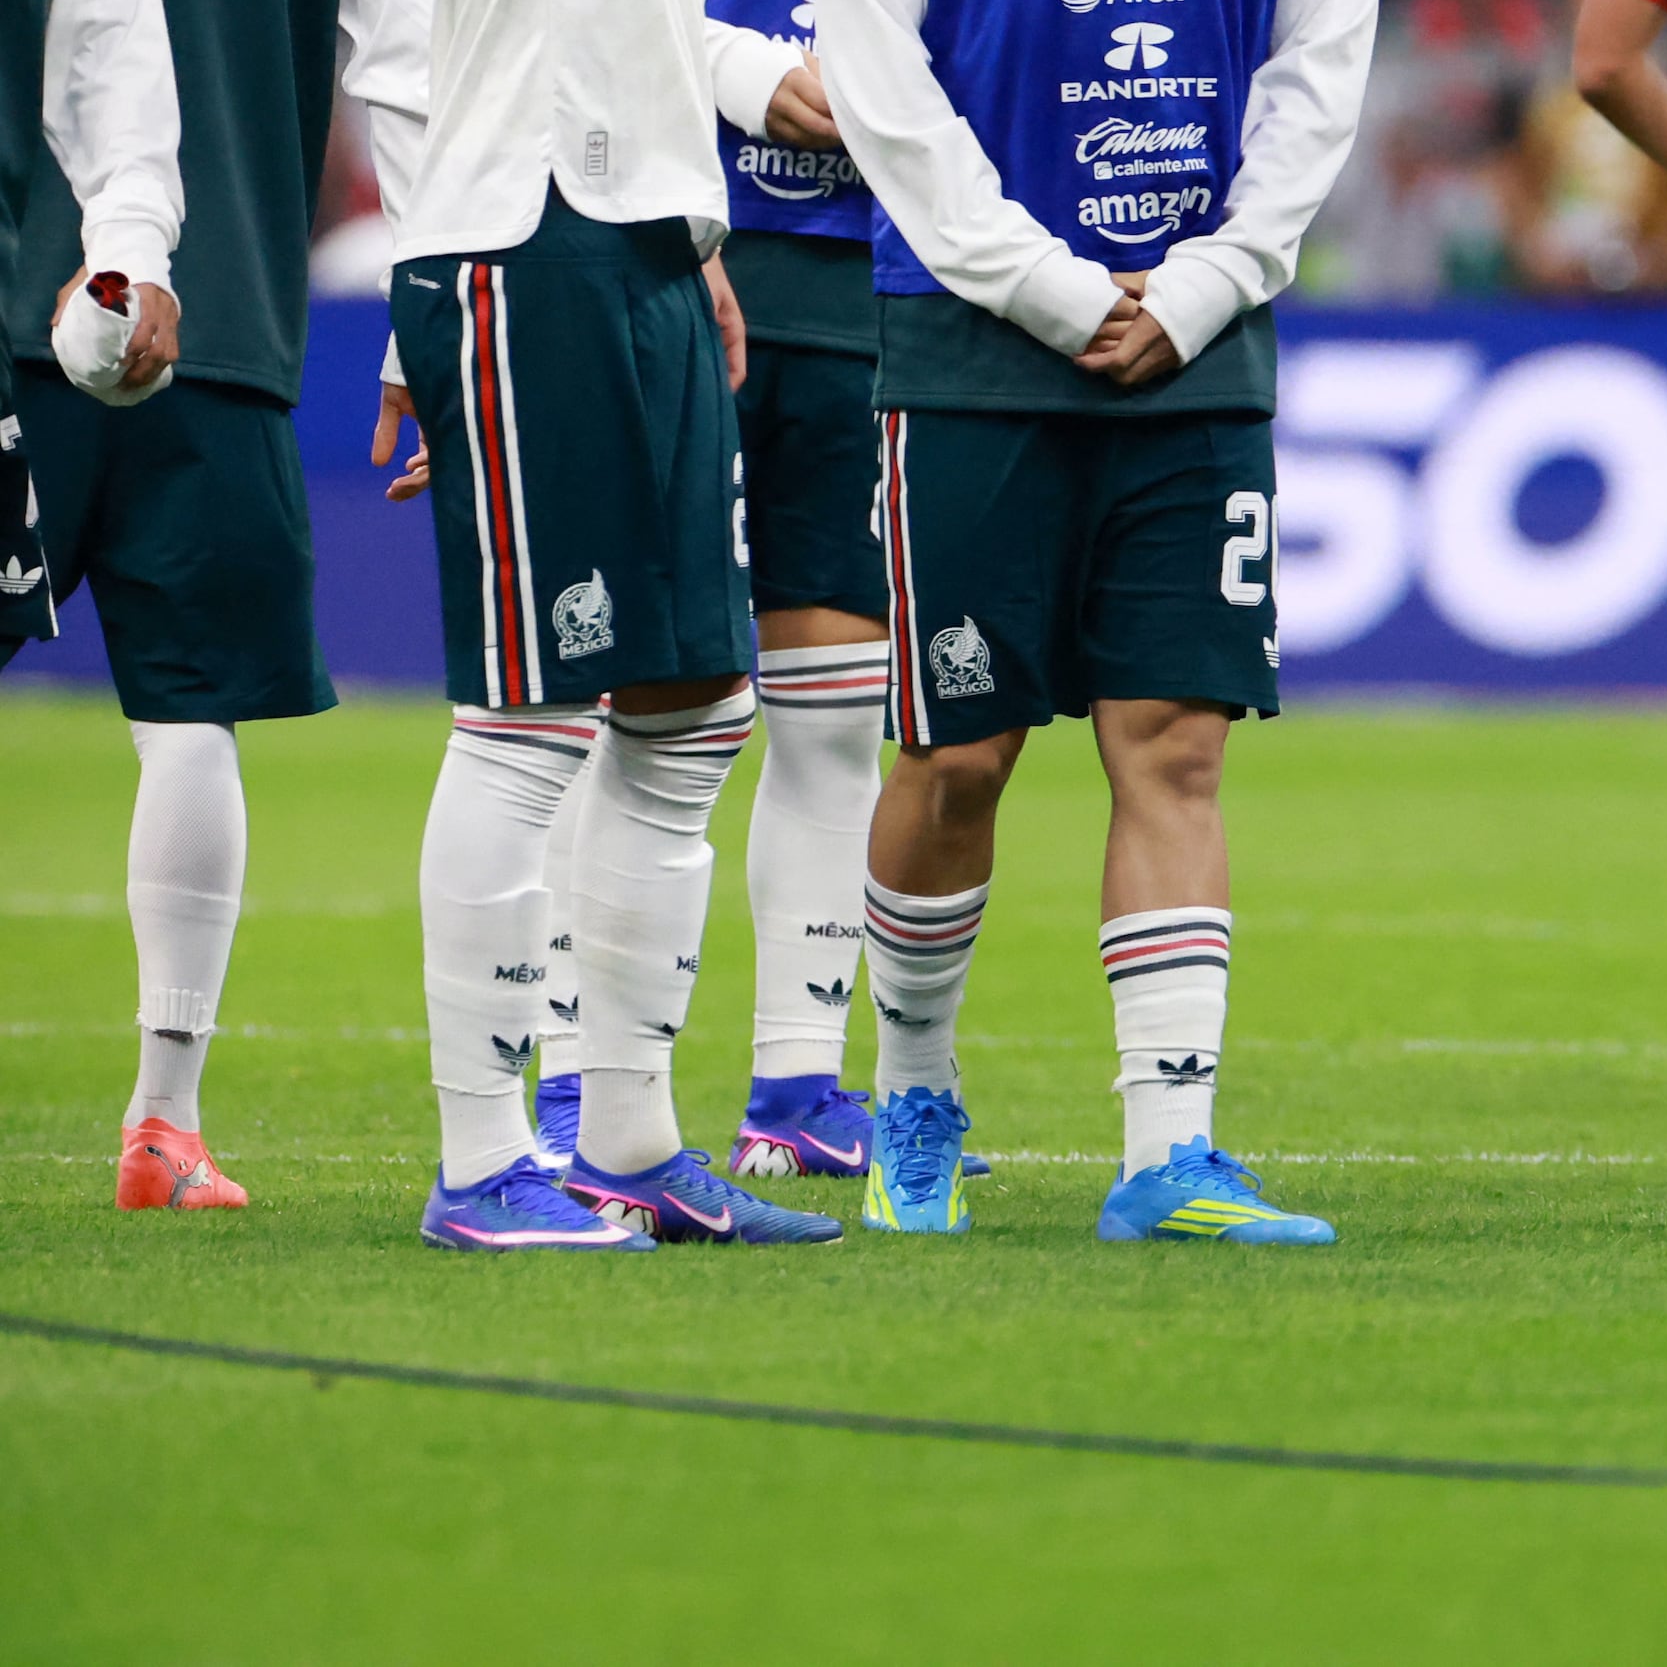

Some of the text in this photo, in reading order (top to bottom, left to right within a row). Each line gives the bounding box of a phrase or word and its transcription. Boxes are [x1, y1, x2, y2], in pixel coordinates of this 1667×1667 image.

[1060, 77, 1218, 103] BANORTE
[1074, 117, 1207, 164] Caliente
[1113, 158, 1208, 177] caliente.mx
[1078, 186, 1212, 226] amazon
[1220, 491, 1279, 607] 2
[561, 635, 611, 655] MÉXICO
[939, 680, 991, 698] MÉXICO
